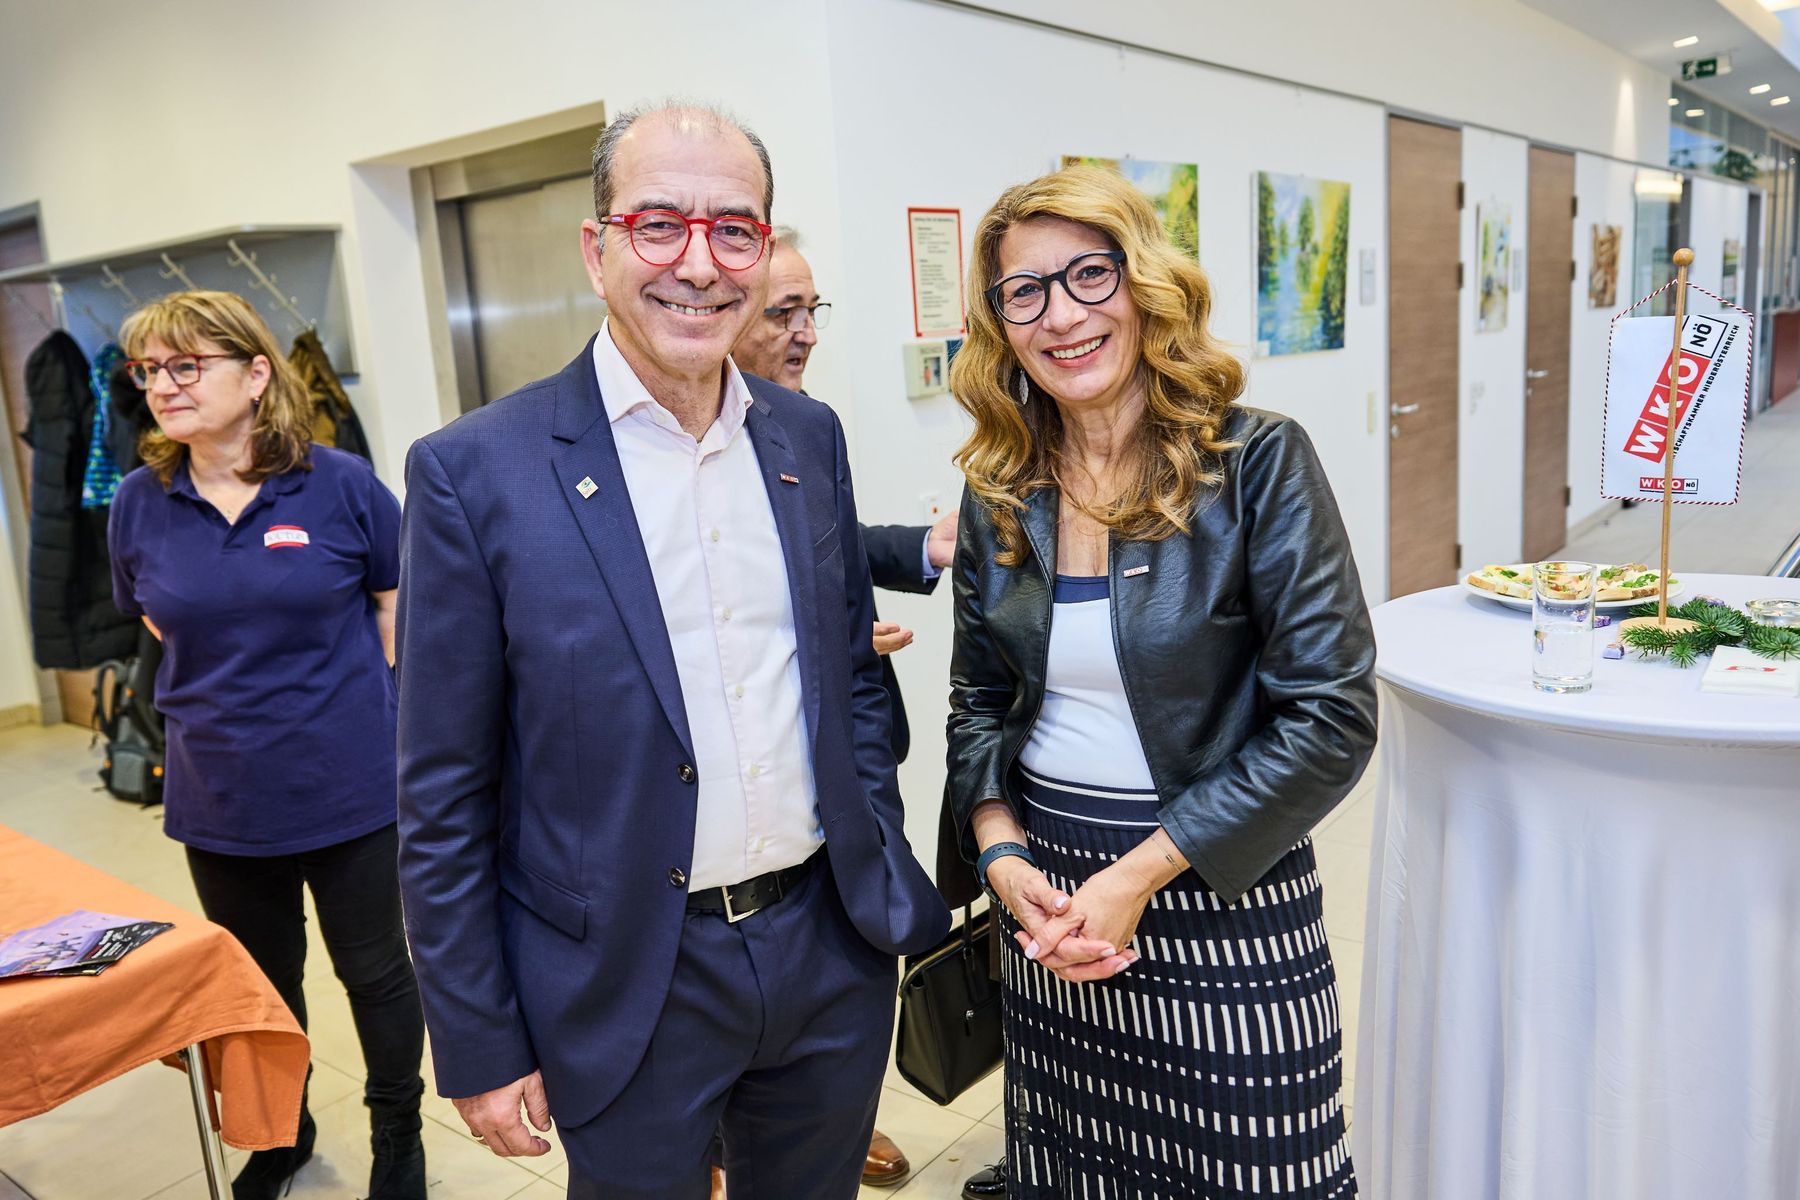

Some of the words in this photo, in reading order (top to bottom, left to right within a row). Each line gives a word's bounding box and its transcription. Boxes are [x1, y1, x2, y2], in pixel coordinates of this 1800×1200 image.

[1629, 357, 1699, 455] WKO
[1690, 323, 1712, 348] NÖ
[1672, 393, 1706, 460] TSCHAFTSKAMMER
[1702, 324, 1740, 393] NIEDERÖSTERREICH
[1641, 478, 1682, 489] WKO
